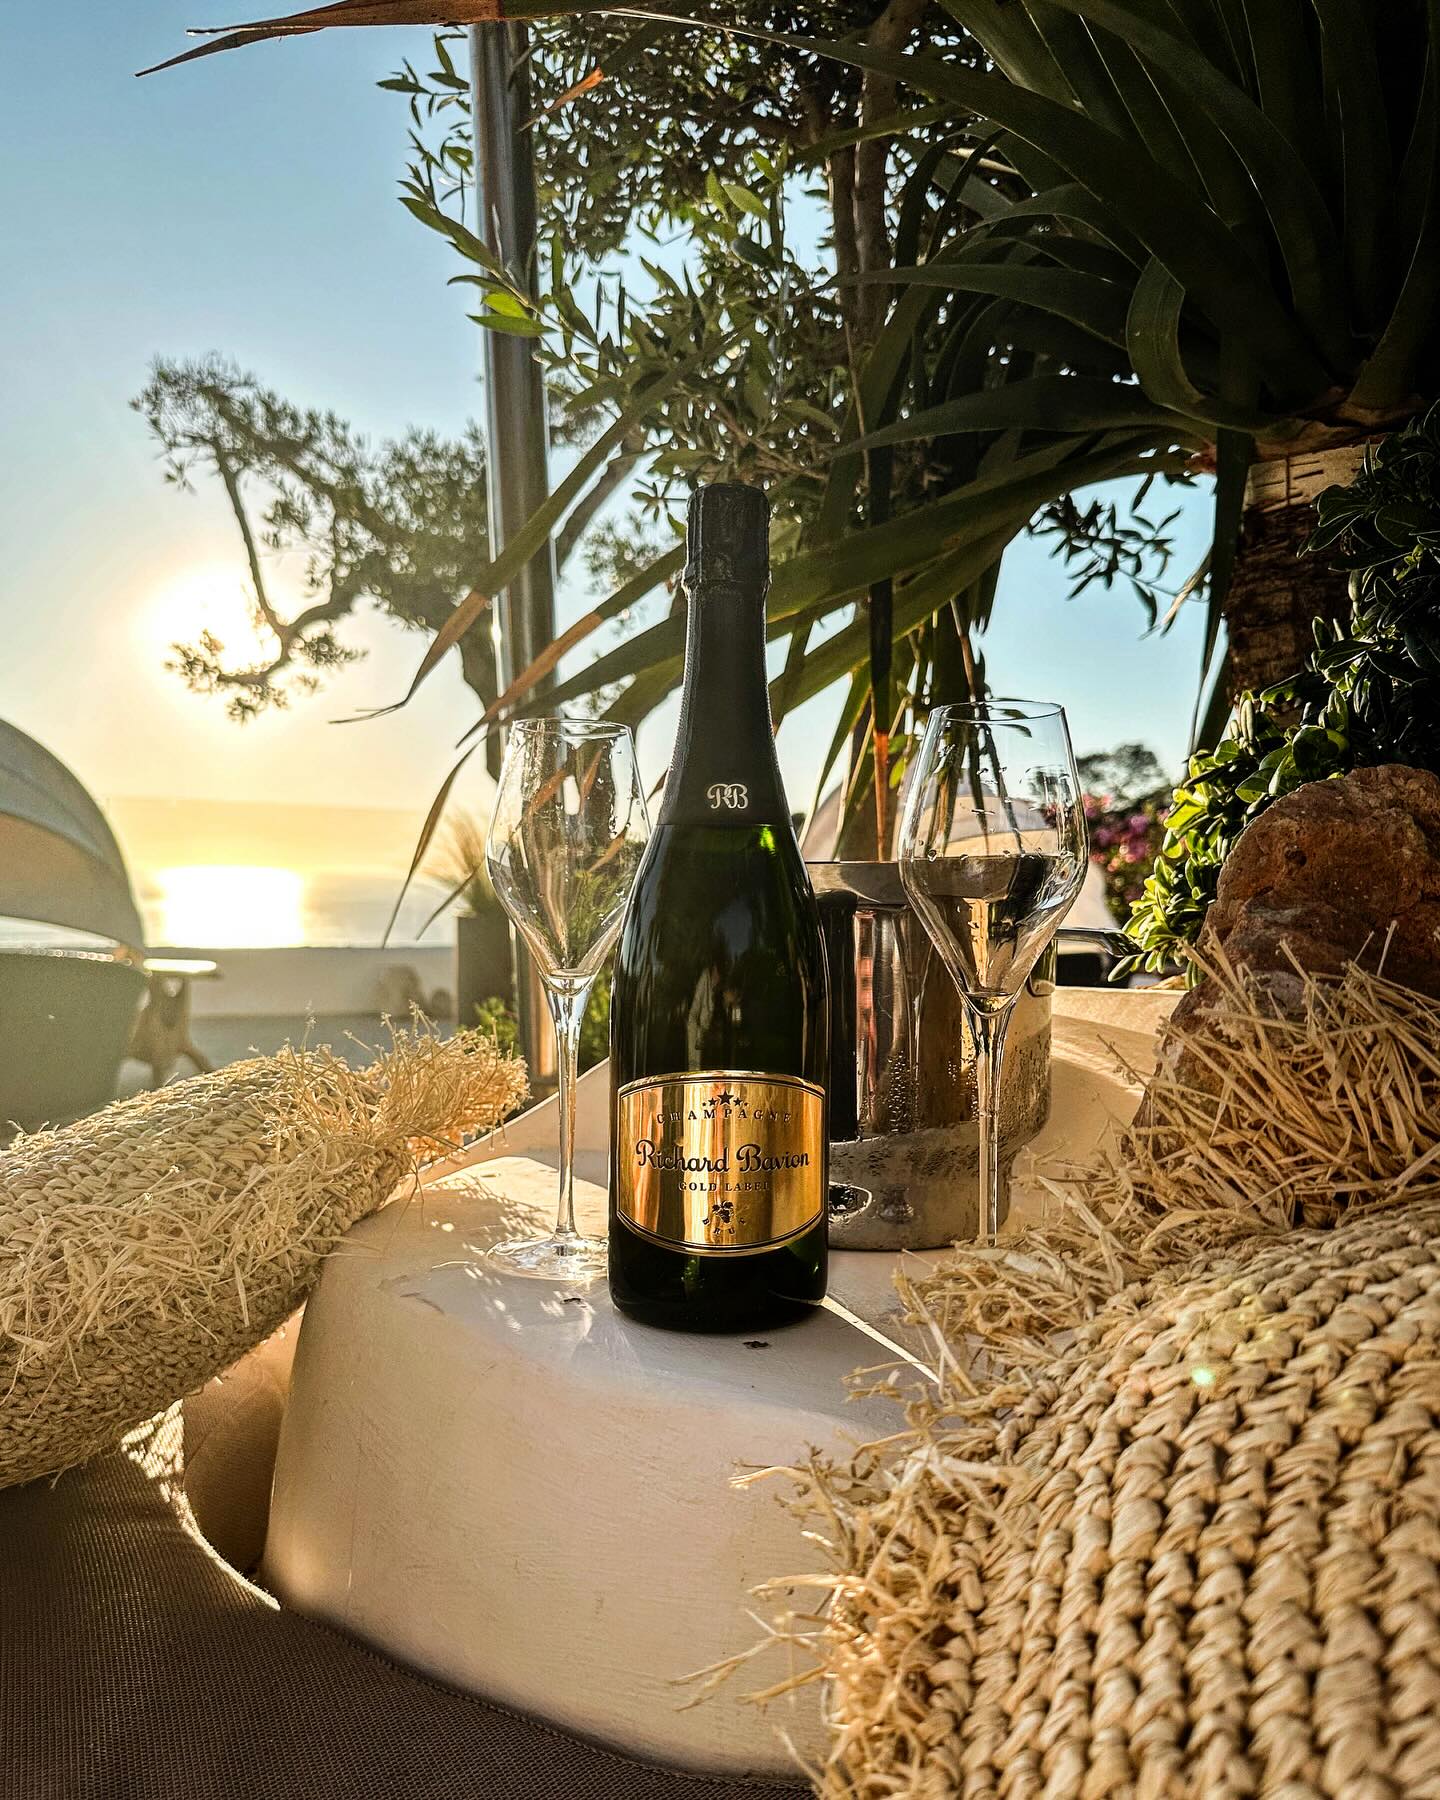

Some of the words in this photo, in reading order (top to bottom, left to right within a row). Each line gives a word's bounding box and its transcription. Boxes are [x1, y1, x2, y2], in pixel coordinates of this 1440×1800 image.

[657, 1108, 792, 1124] CHAMPAGNE
[636, 1139, 730, 1172] Richard
[736, 1143, 809, 1172] Bavion
[679, 1182, 717, 1191] GOLD
[725, 1182, 769, 1191] LABEL
